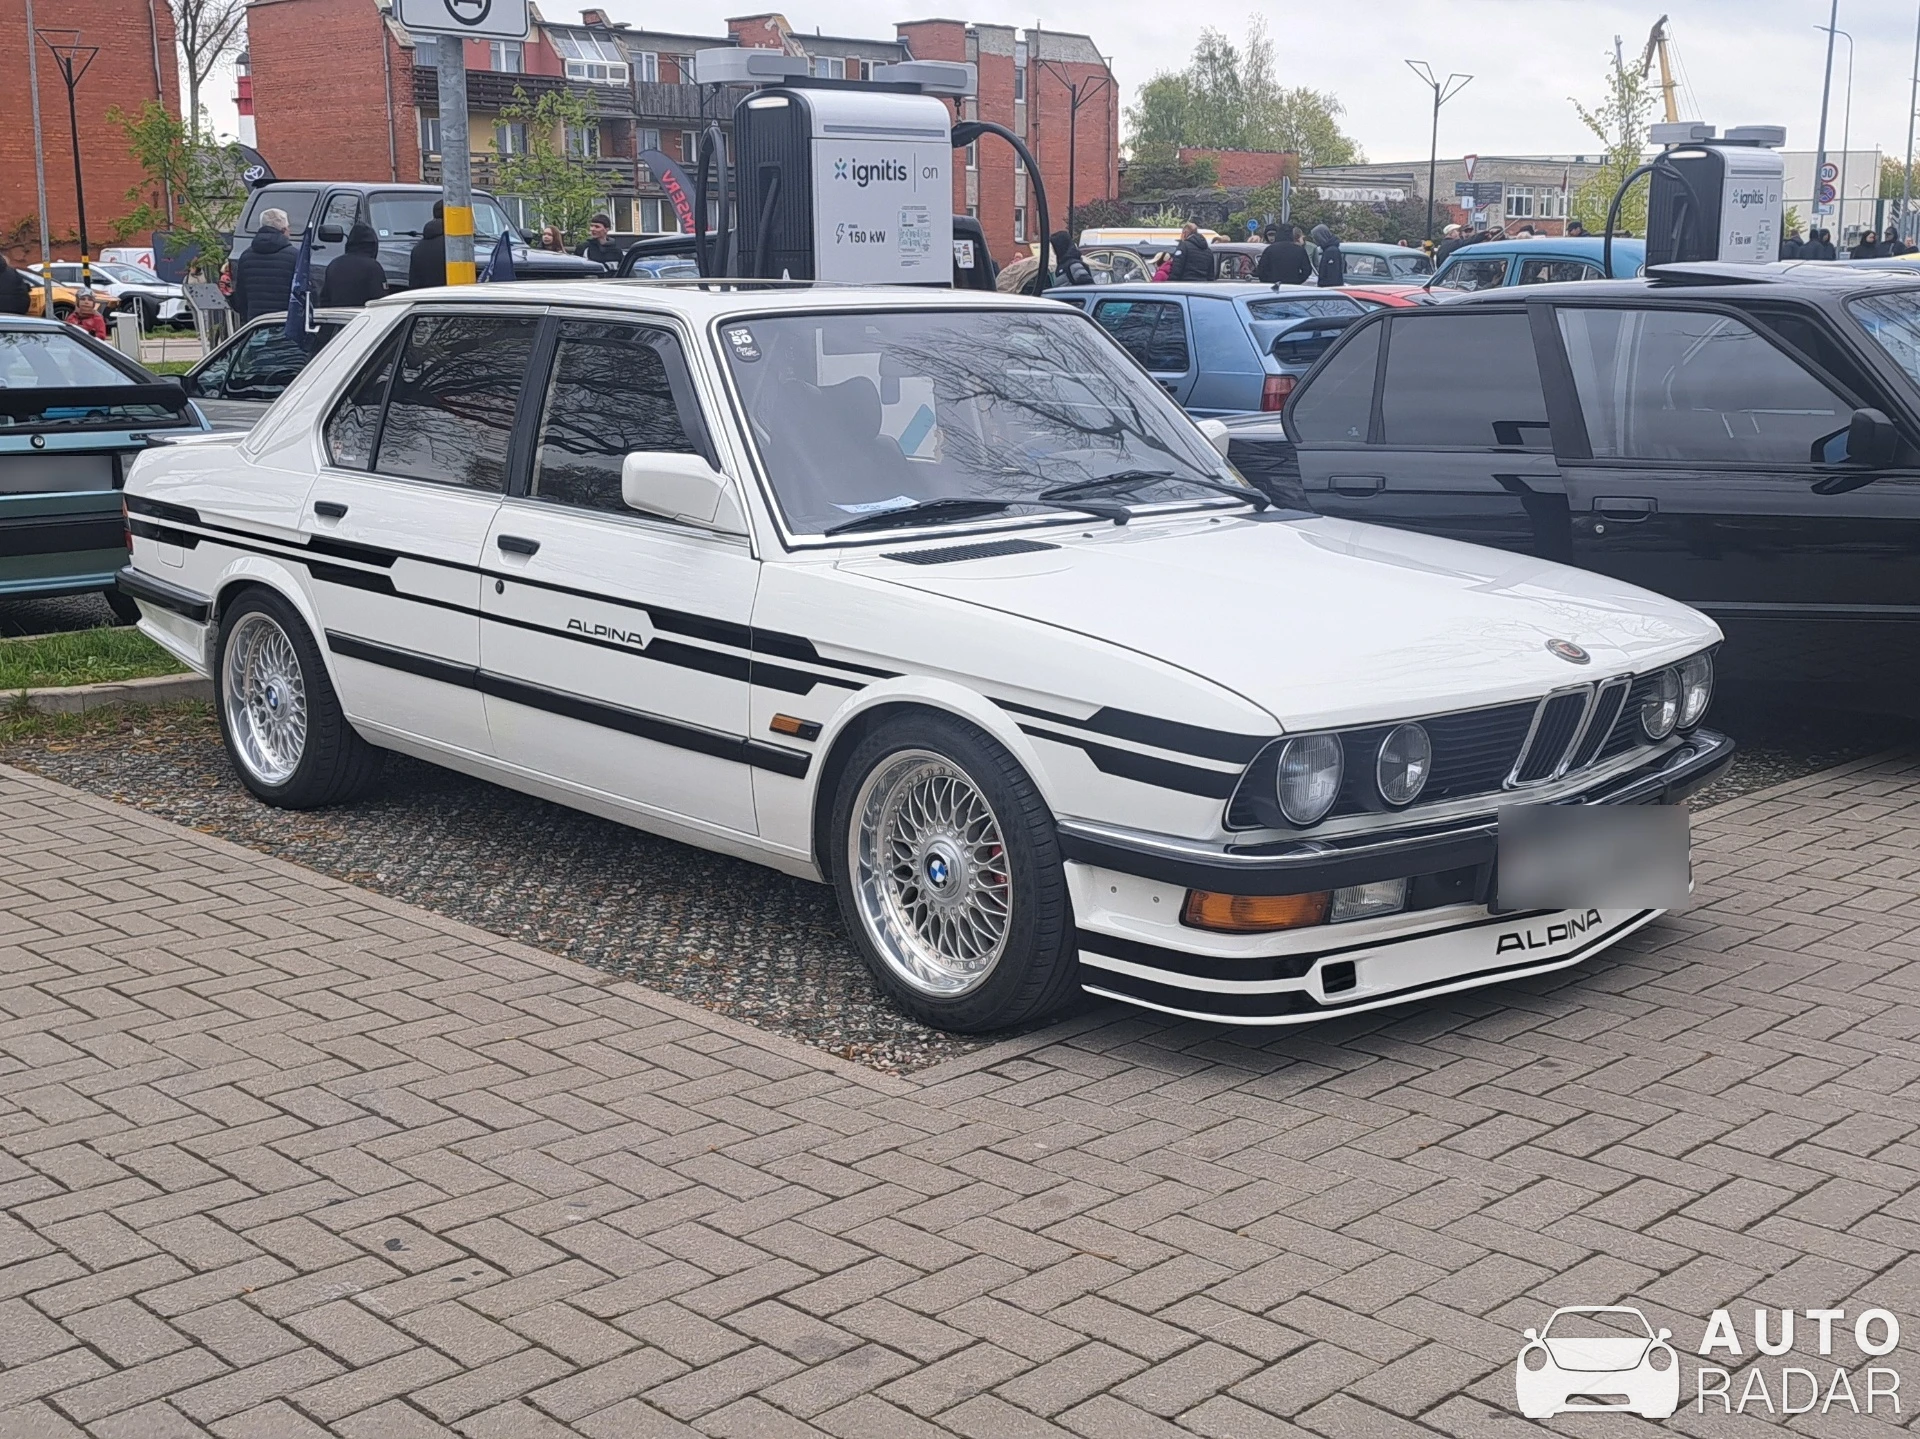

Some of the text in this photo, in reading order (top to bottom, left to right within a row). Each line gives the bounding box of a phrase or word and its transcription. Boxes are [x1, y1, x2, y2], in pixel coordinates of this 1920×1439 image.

[851, 157, 939, 188] ignitis on
[1822, 168, 1833, 178] 30
[1740, 188, 1764, 209] ignitis
[848, 230, 886, 243] 150 kW
[728, 329, 748, 337] TOP
[731, 334, 753, 345] 50
[566, 618, 643, 646] ALPINA
[1496, 908, 1602, 955] ALPINA
